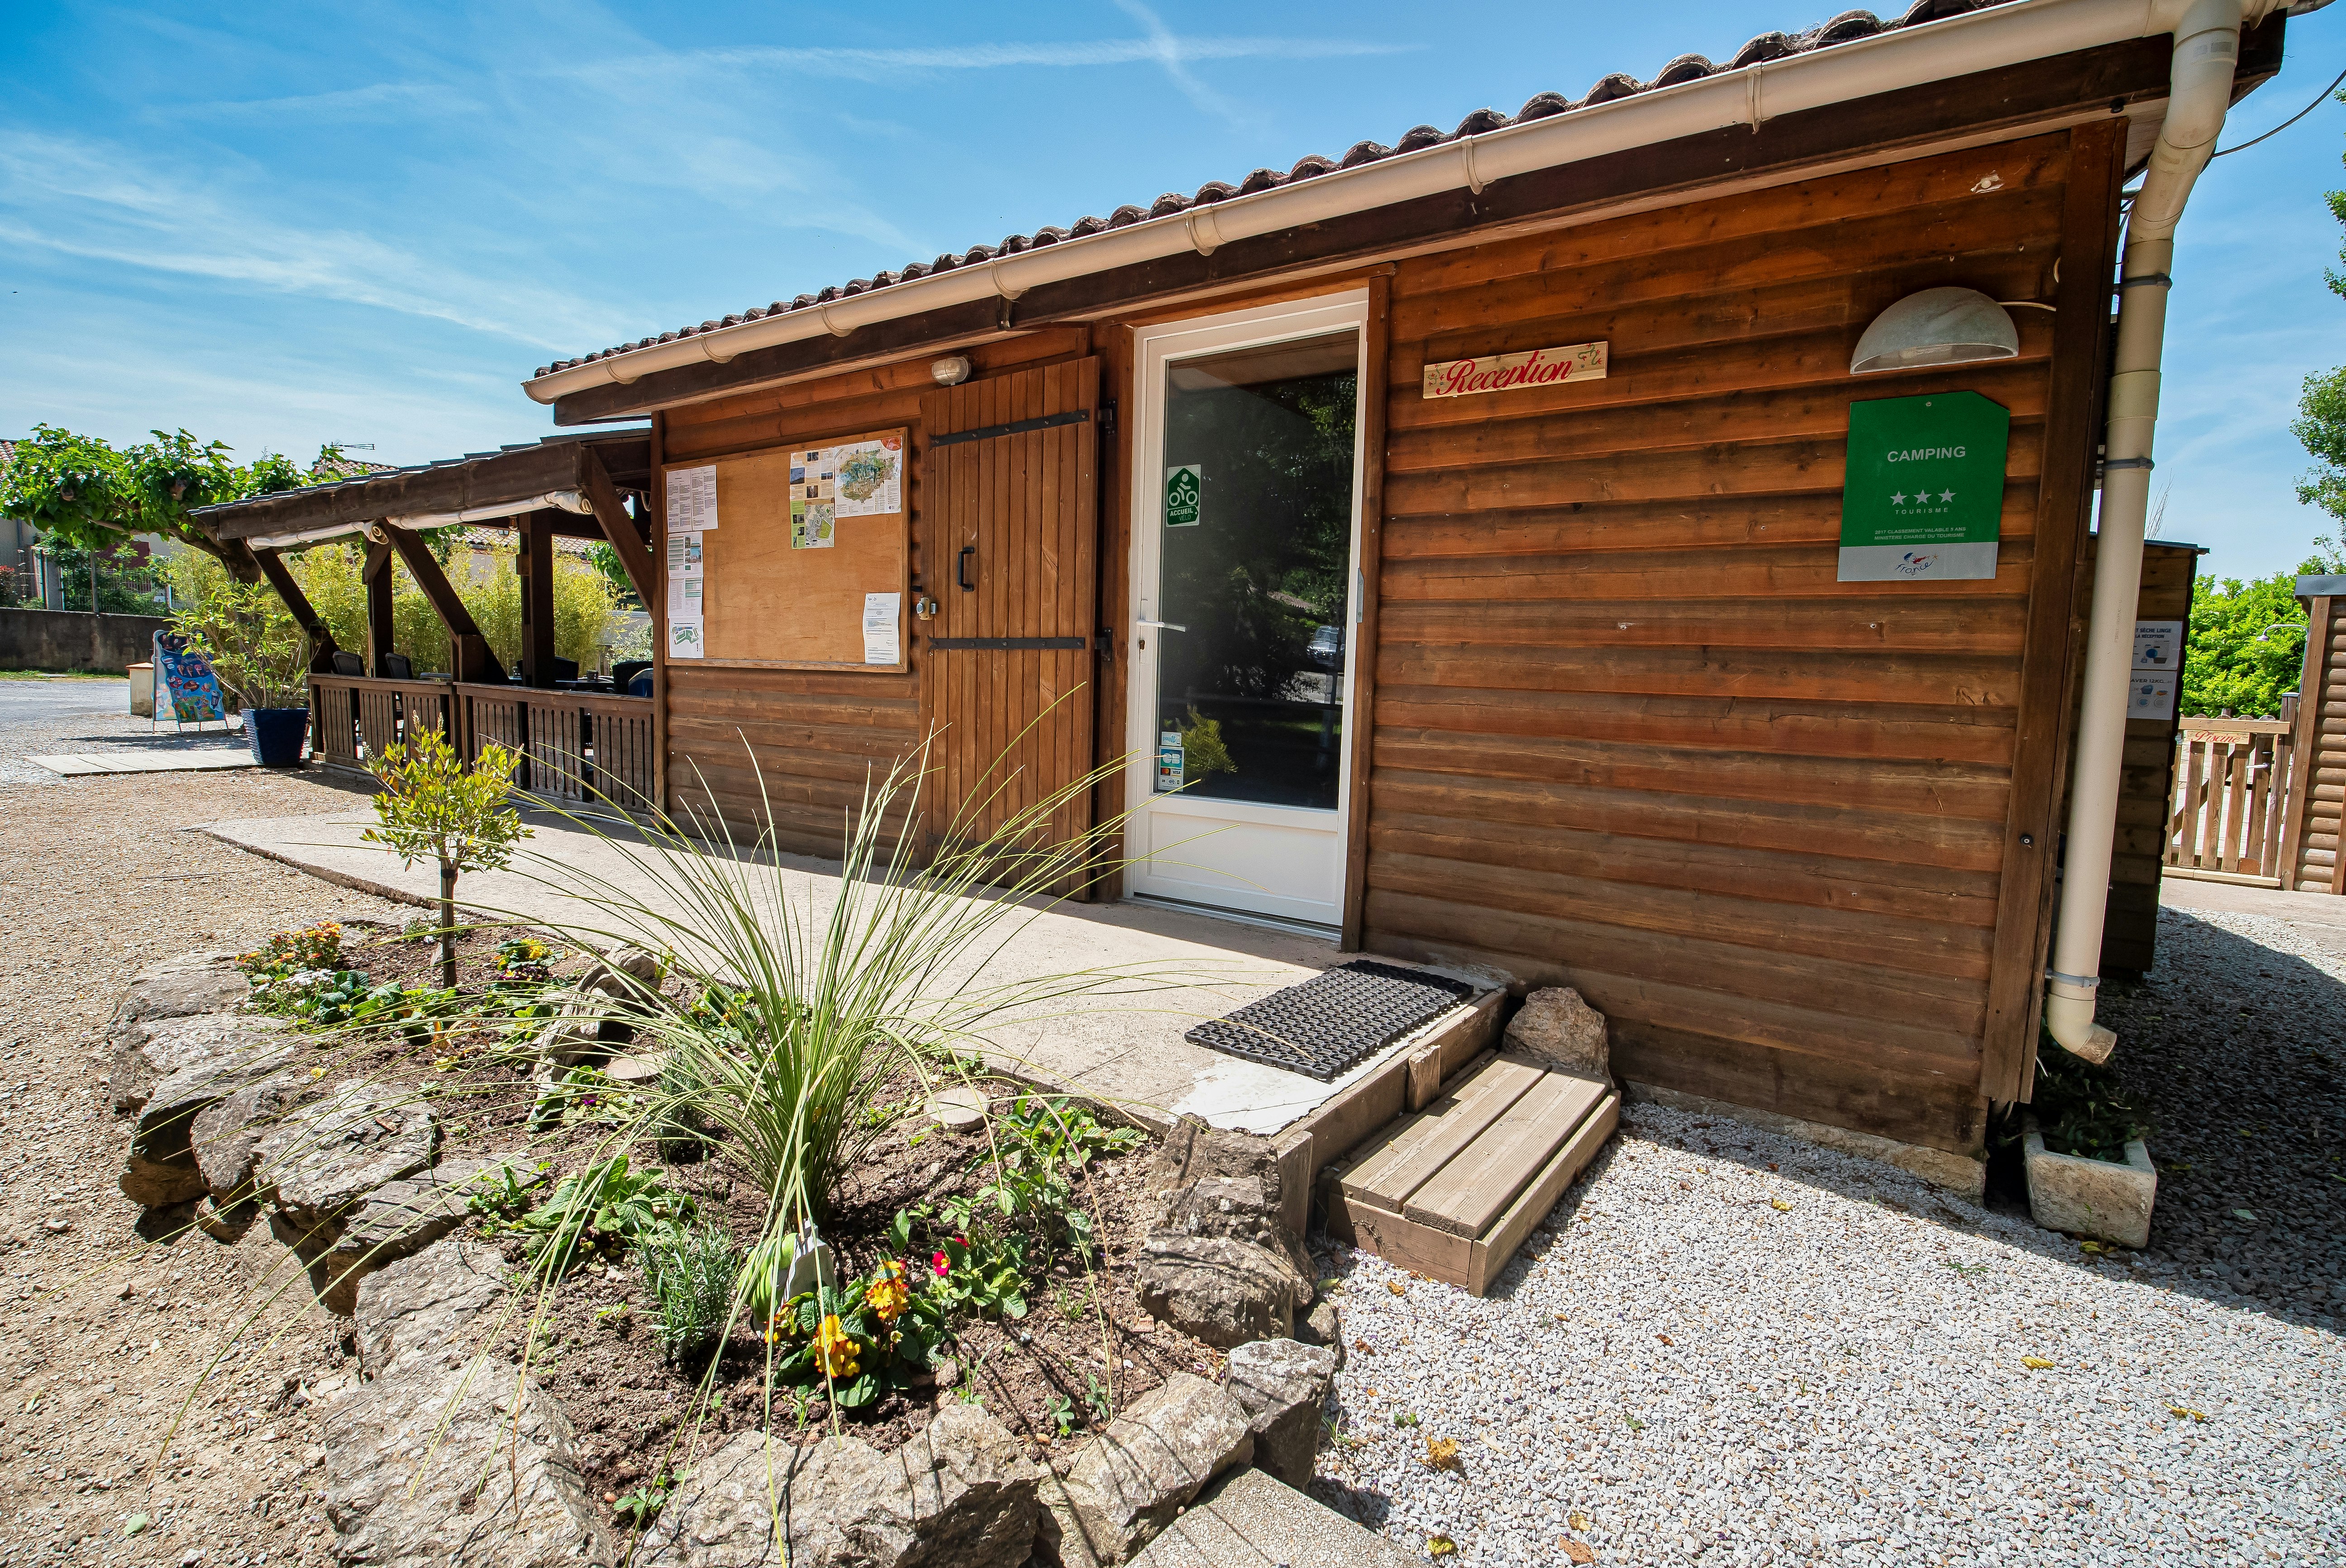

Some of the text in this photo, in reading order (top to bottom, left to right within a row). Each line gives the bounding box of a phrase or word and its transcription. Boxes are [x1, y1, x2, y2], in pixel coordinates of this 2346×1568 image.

[1436, 351, 1574, 395] Reception
[1887, 446, 1966, 462] CAMPING
[1170, 508, 1193, 517] ACCUEIL
[2191, 730, 2240, 743] Piscine
